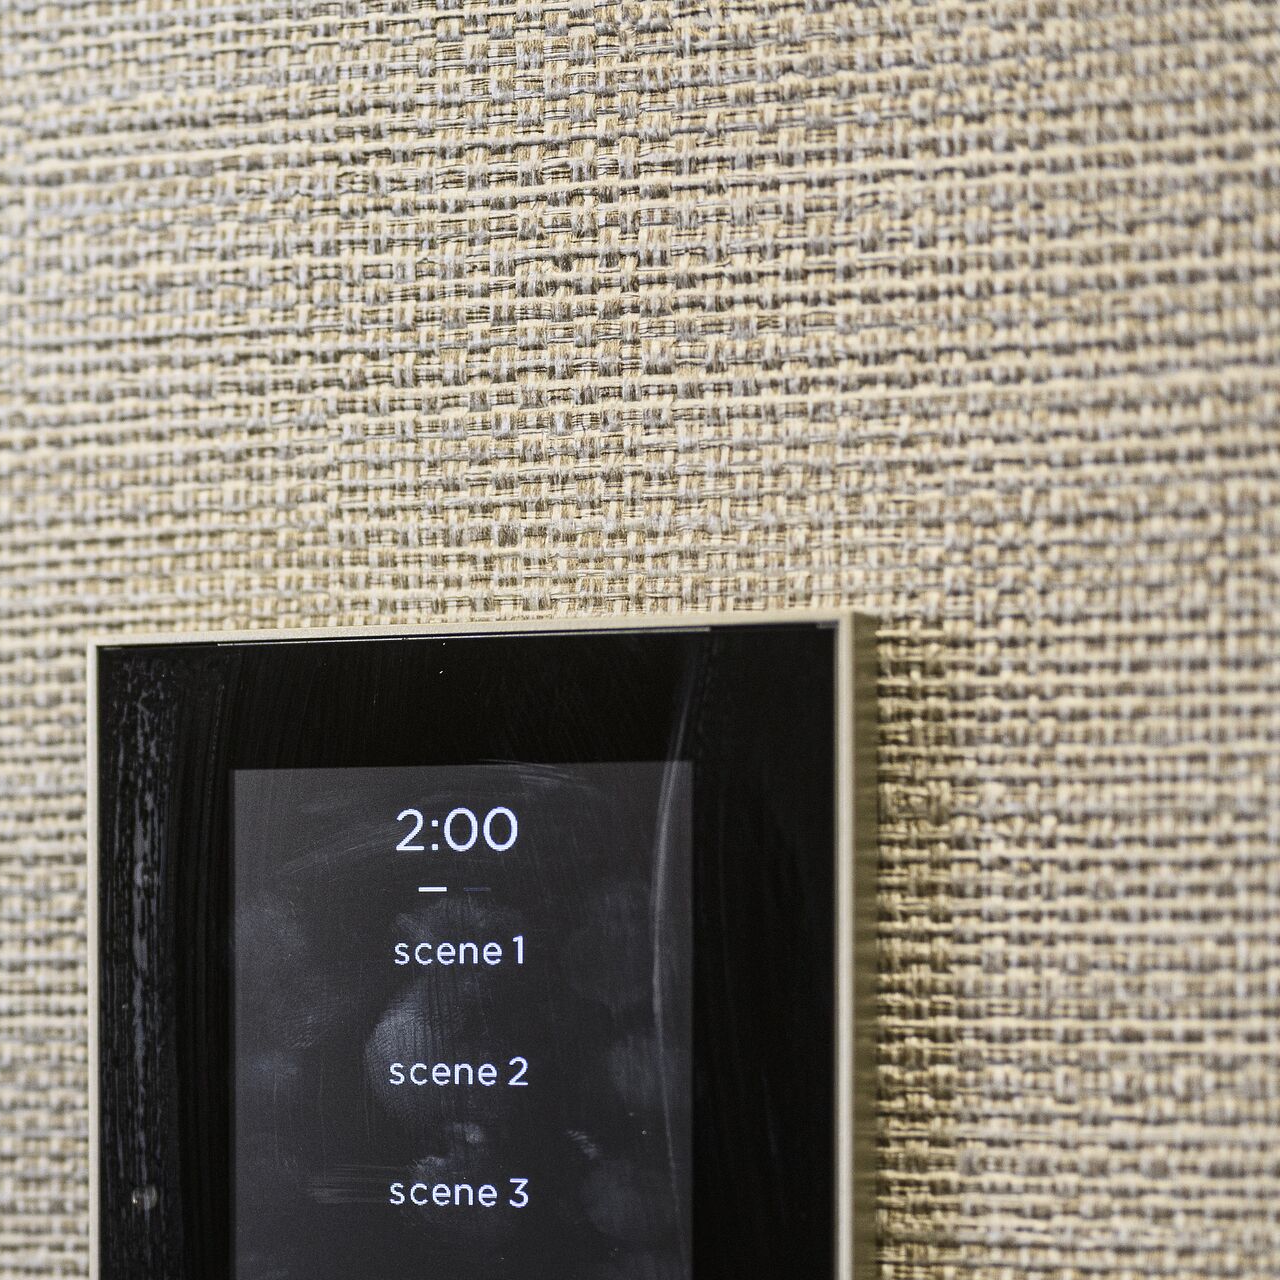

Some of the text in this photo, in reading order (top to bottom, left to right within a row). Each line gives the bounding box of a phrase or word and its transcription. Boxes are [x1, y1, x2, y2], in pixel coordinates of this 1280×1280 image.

[395, 806, 519, 852] 2:00
[394, 935, 524, 966] scene 1
[389, 1056, 529, 1086] scene 2
[389, 1177, 529, 1208] scene 3
